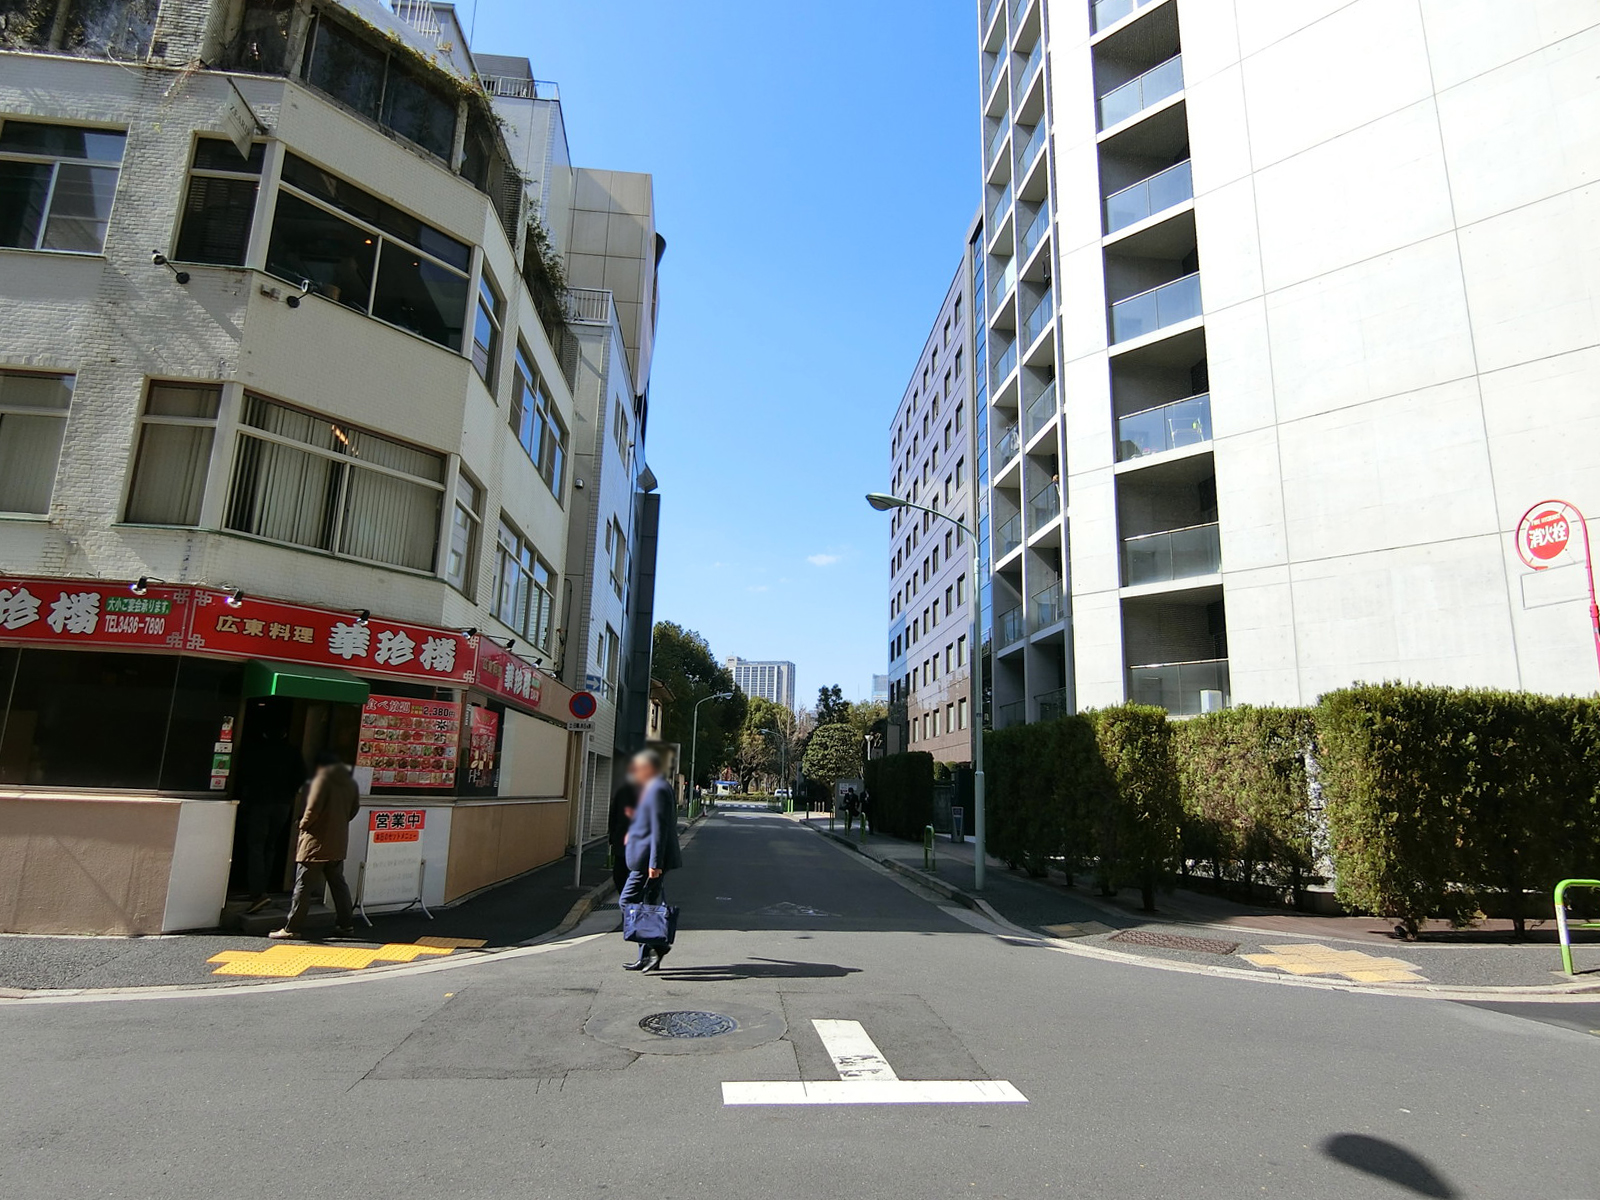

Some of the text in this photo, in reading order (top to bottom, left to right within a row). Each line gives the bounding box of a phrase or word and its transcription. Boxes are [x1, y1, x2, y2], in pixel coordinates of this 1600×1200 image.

[1528, 521, 1567, 549] 消火栓
[215, 615, 315, 643] 広東料理
[365, 698, 411, 713] 食べ放題
[375, 811, 421, 829] 営業中
